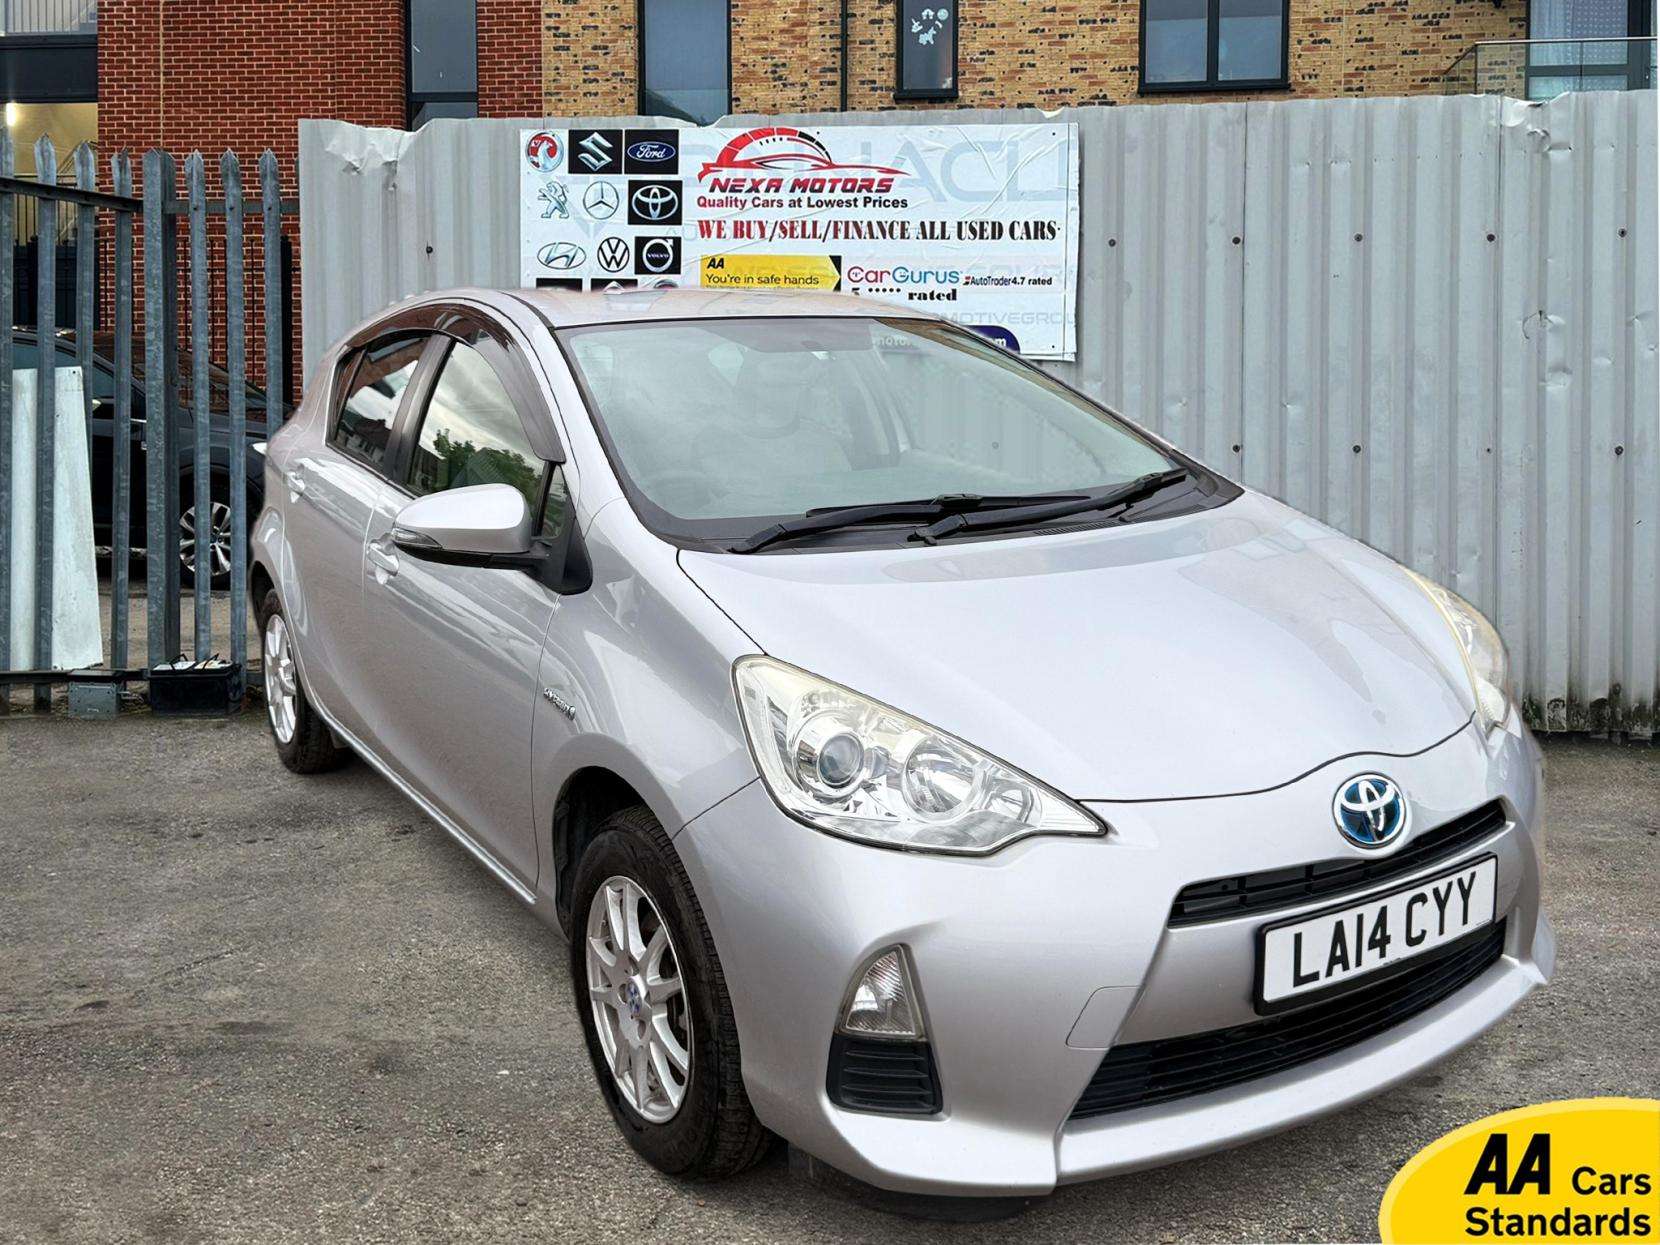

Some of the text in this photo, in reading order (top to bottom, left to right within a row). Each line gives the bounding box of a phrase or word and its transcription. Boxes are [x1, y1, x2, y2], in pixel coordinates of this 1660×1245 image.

[636, 144, 666, 158] Ford
[708, 178, 895, 194] NEXA MOTORS
[697, 195, 908, 211] Quality Cars at Lowest Prices
[698, 219, 727, 240] WE
[916, 220, 951, 241] ALL
[956, 220, 1004, 241] USED
[1008, 220, 1057, 241] CARS
[706, 257, 725, 269] AA
[706, 273, 820, 285] You're in safe hands
[847, 266, 960, 284] CarGurus
[1028, 276, 1053, 285] rated
[908, 288, 957, 301] rated
[1293, 871, 1477, 988] LA14 CYY
